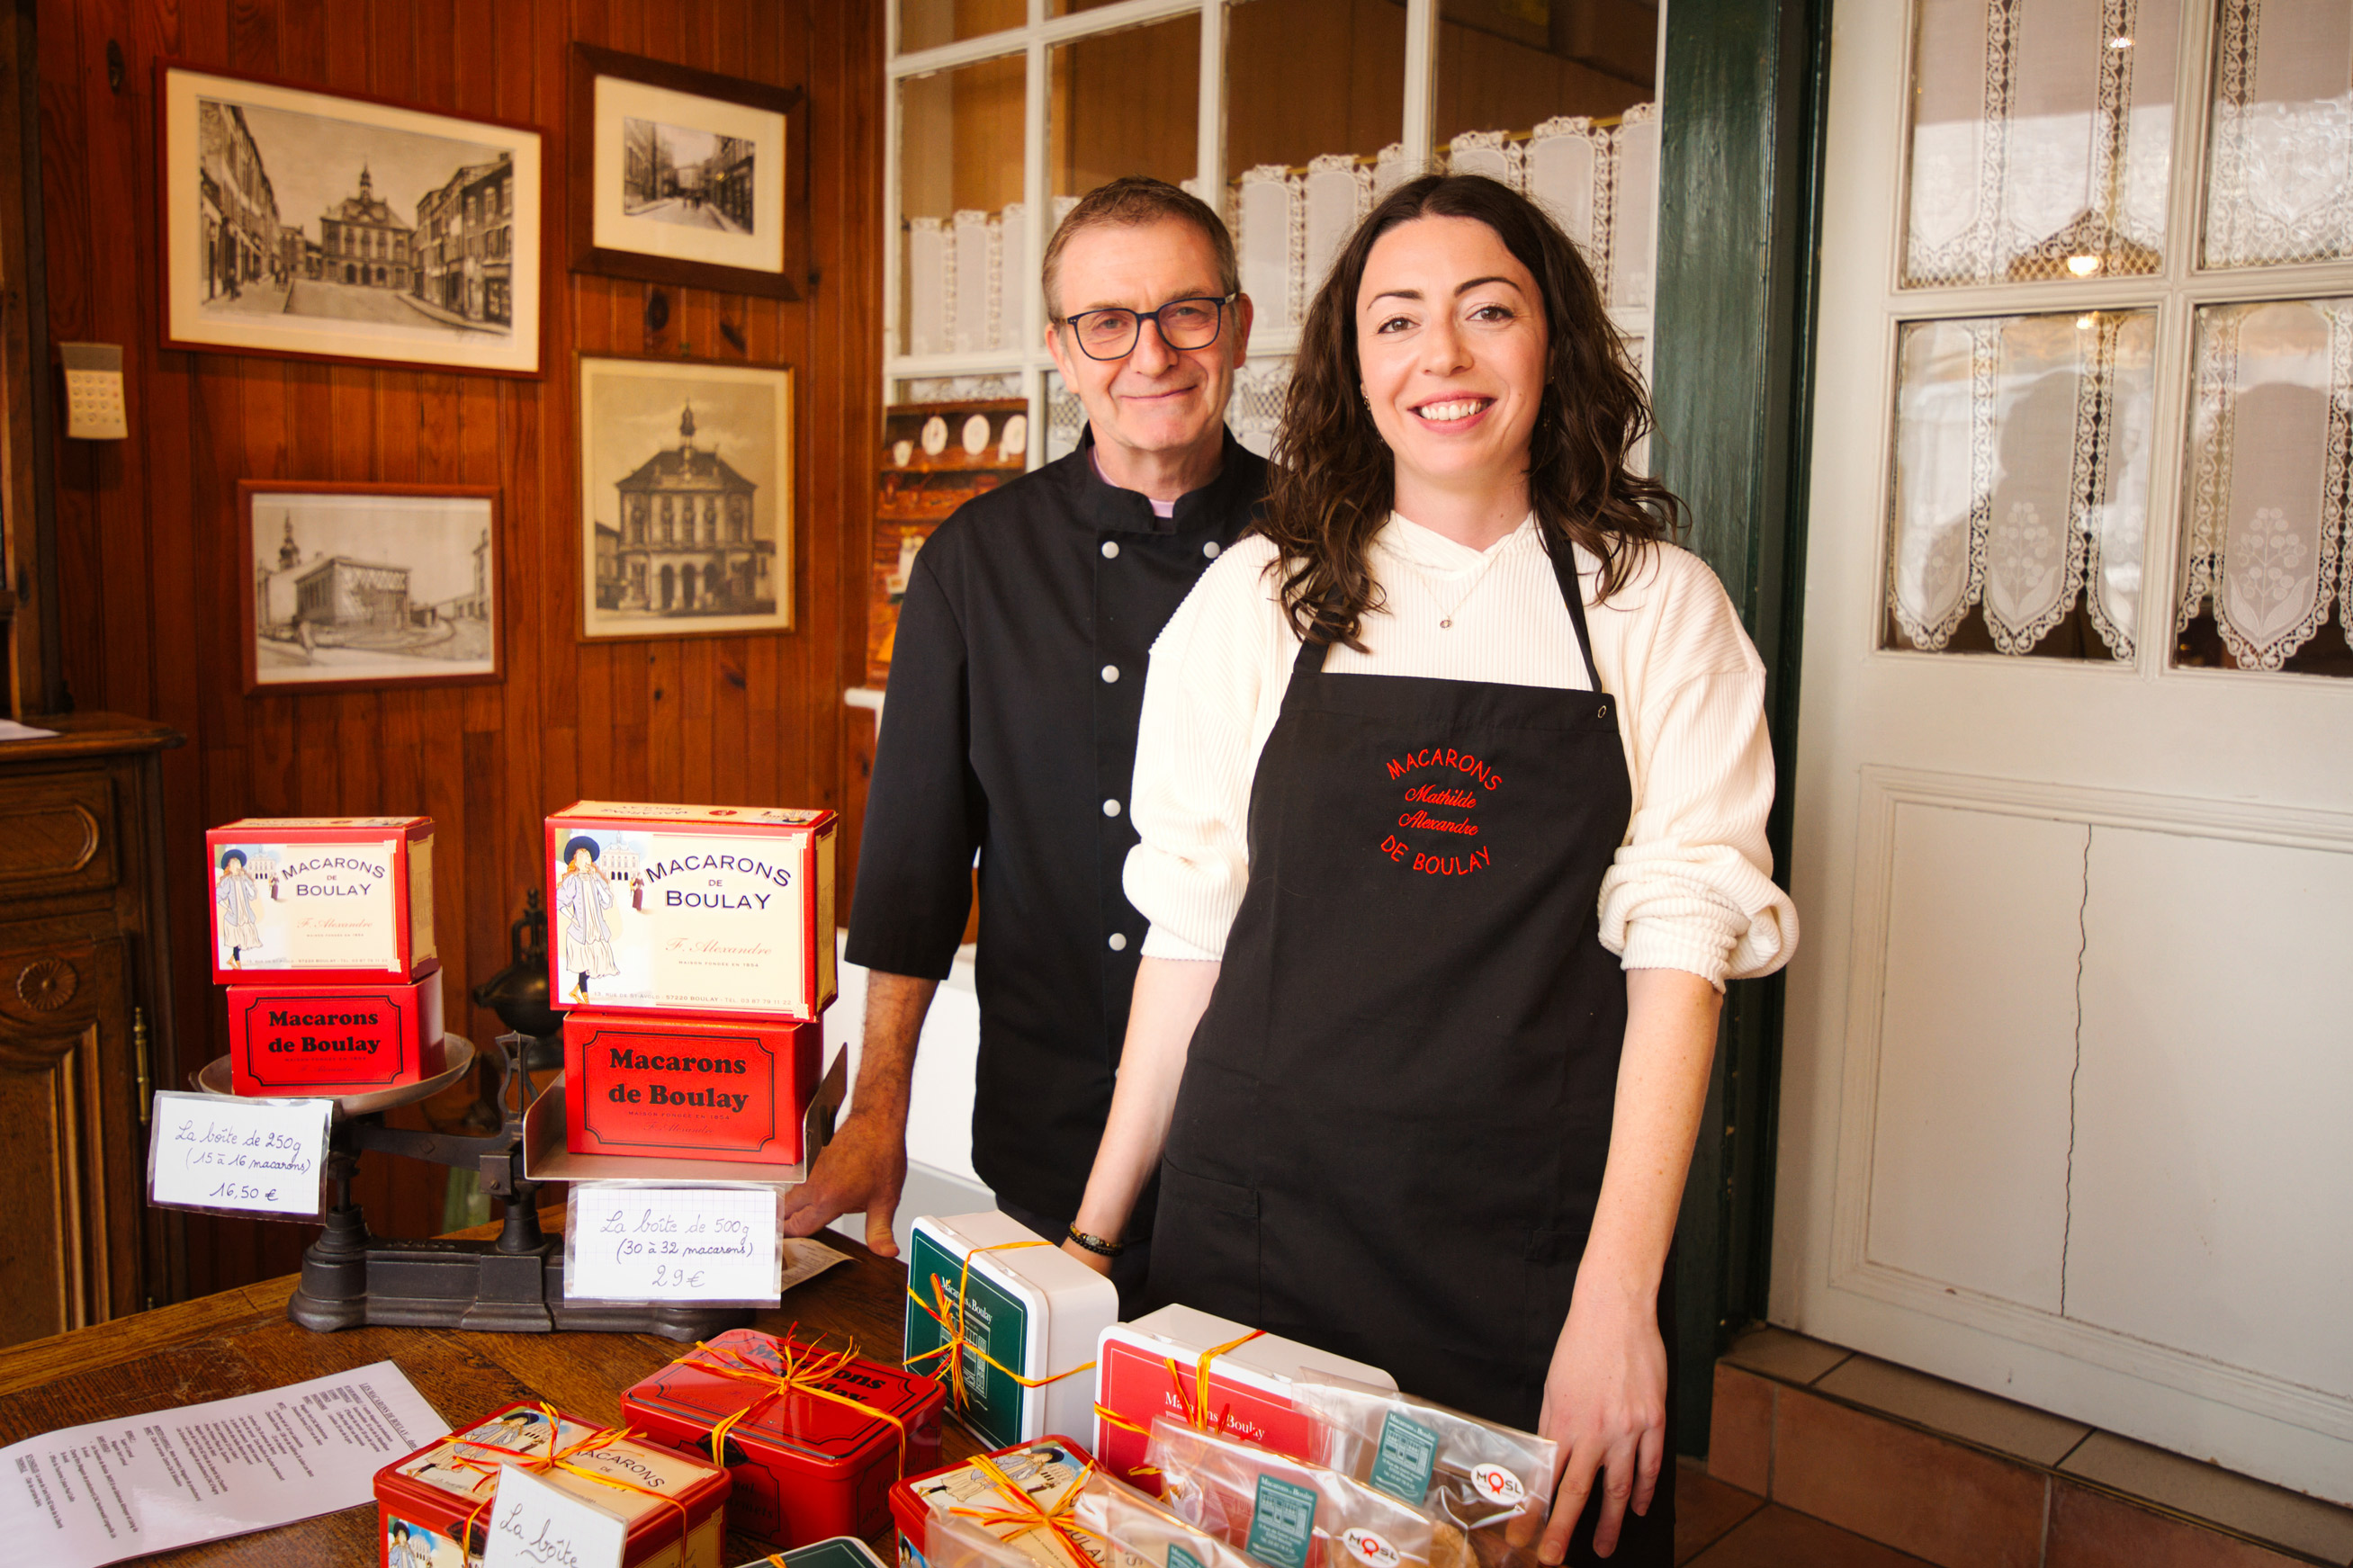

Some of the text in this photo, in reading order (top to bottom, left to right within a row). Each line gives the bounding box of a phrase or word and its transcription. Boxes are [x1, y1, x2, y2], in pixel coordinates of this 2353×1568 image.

[1387, 748, 1502, 791] MACARONS
[1405, 784, 1477, 808] Mathilde
[1398, 810, 1478, 836] Alexandre
[1380, 835, 1490, 875] DE BOULAY
[282, 857, 385, 880] MACARONS
[645, 855, 792, 887] MACARONS
[297, 883, 372, 896] BOULAY
[666, 890, 771, 910] BOULAY
[296, 918, 373, 928] F. Alexandre
[665, 937, 772, 956] F. Alexandre
[269, 1011, 379, 1026] Macarons
[268, 1036, 381, 1054] de Boulay
[609, 1048, 747, 1074] Macarons
[608, 1083, 750, 1113] de Boulay
[175, 1120, 301, 1162] La boîte de 250g
[185, 1147, 311, 1175] (15 à 16 macarons)
[210, 1182, 279, 1201] 16,50 €
[600, 1208, 750, 1245] La boîte de 500g
[616, 1238, 754, 1265] (30 à 32 macarons)
[941, 1277, 969, 1306] Macars
[972, 1298, 992, 1324] Boulay
[365, 1390, 391, 1413] MACARONS
[1165, 1391, 1218, 1421] Maans
[576, 1448, 665, 1488] ACARONS
[499, 1502, 524, 1540] La
[529, 1518, 579, 1568] boîte
